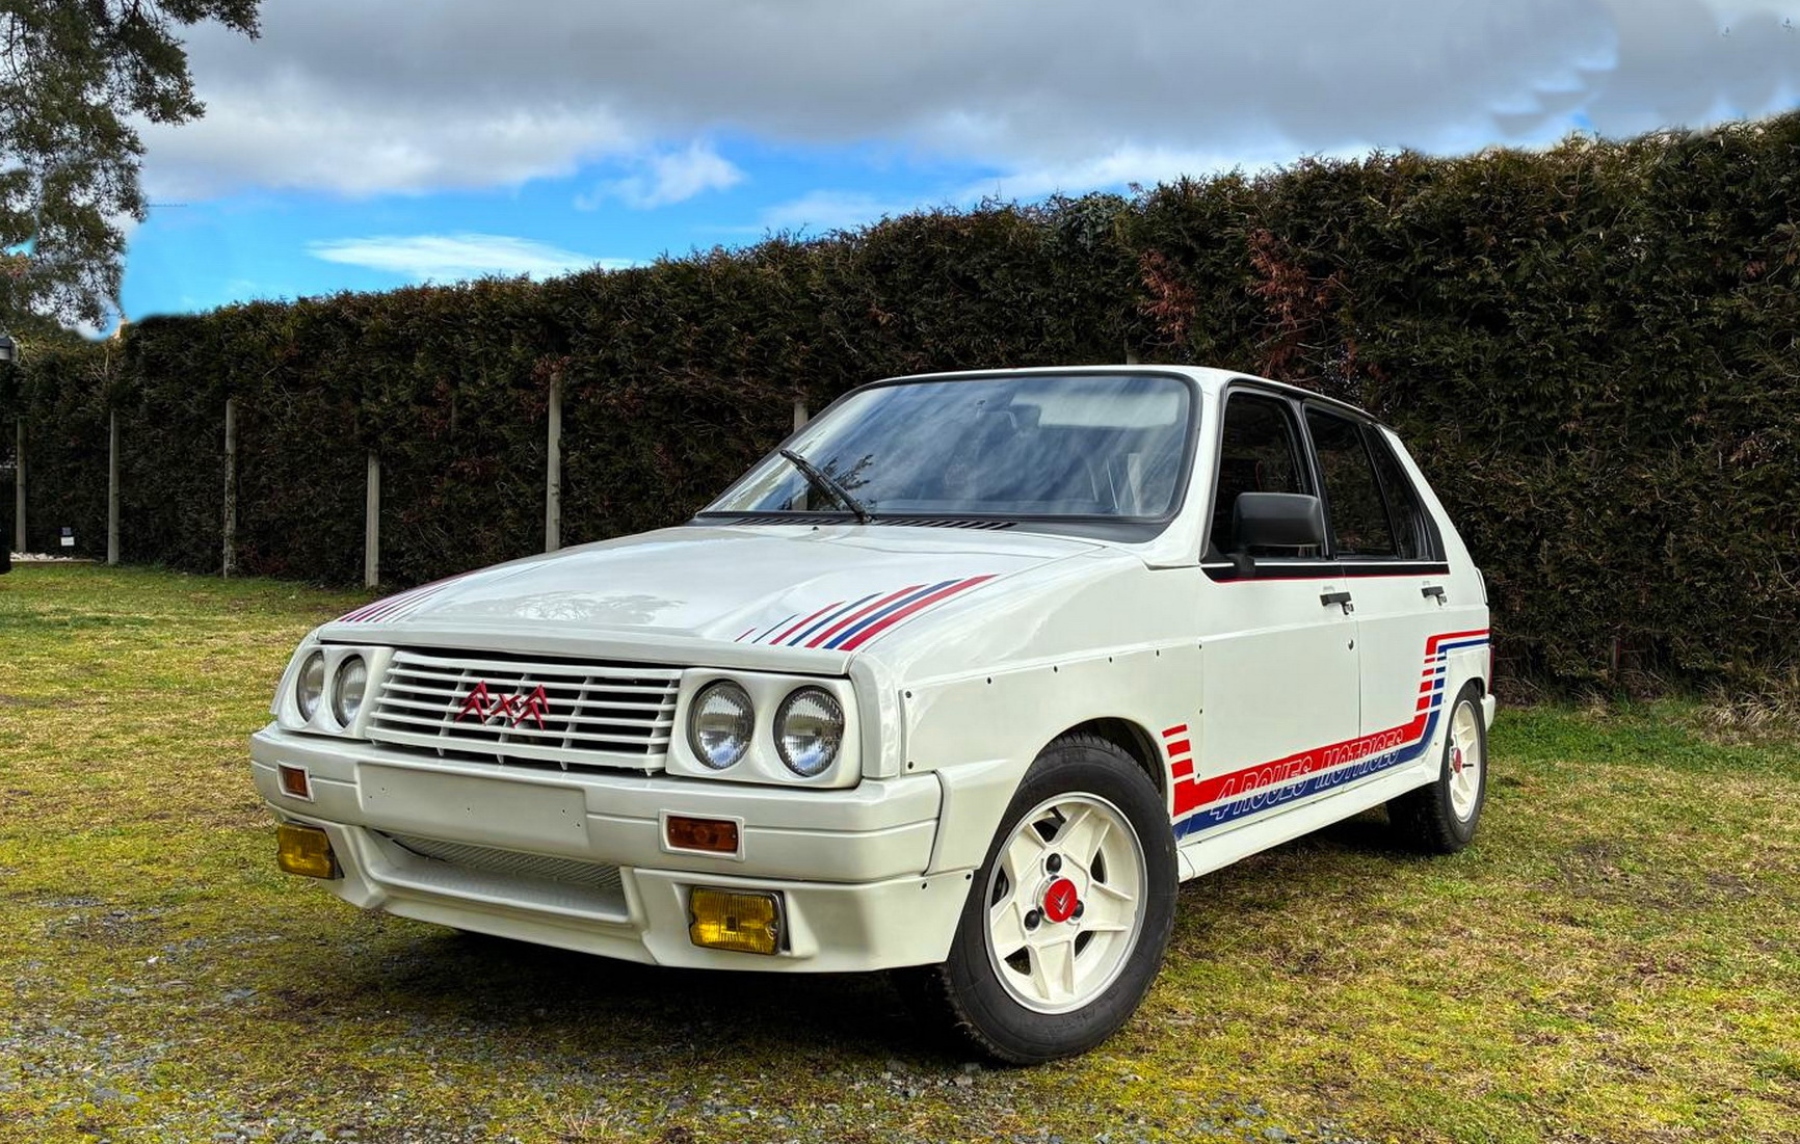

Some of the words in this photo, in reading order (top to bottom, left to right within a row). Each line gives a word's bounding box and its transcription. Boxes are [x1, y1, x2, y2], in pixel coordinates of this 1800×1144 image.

[1209, 778, 1235, 820] 4
[1233, 755, 1313, 815] ROUES
[1314, 729, 1404, 789] MOTRICES
